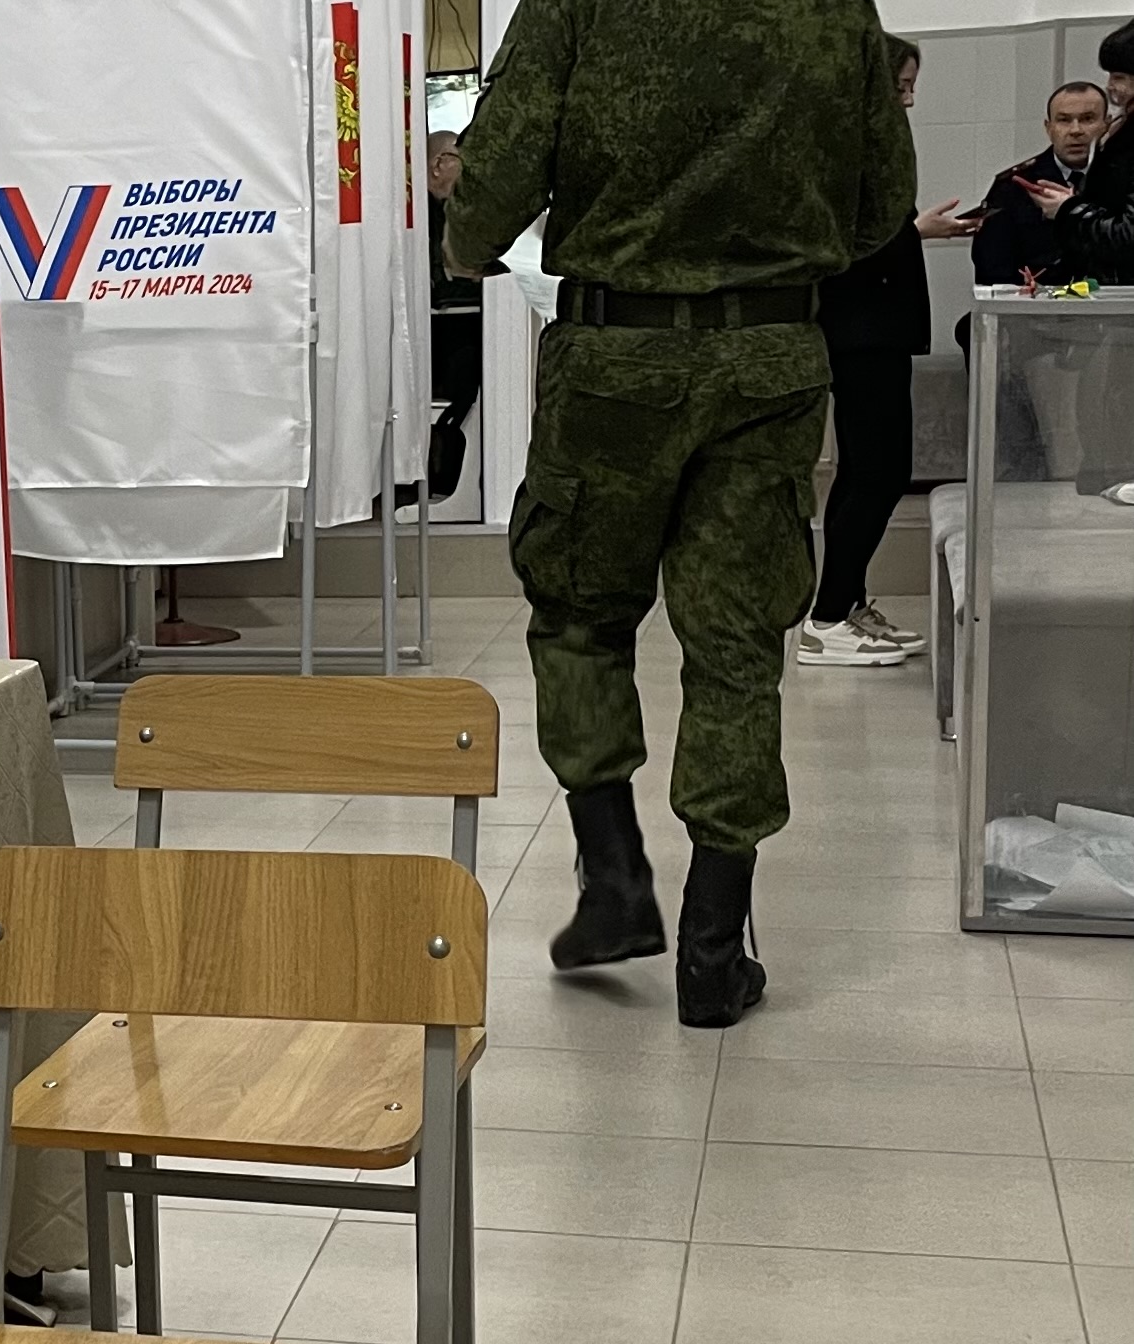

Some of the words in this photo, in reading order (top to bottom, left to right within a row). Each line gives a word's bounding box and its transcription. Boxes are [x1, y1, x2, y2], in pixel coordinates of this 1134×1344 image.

[123, 179, 243, 207] ВЫБОРЫ
[110, 210, 277, 240] ПРЕЗИДЕНТА
[97, 243, 205, 272] РОССИИ
[141, 274, 205, 298] МАРТА
[207, 273, 253, 295] 2024
